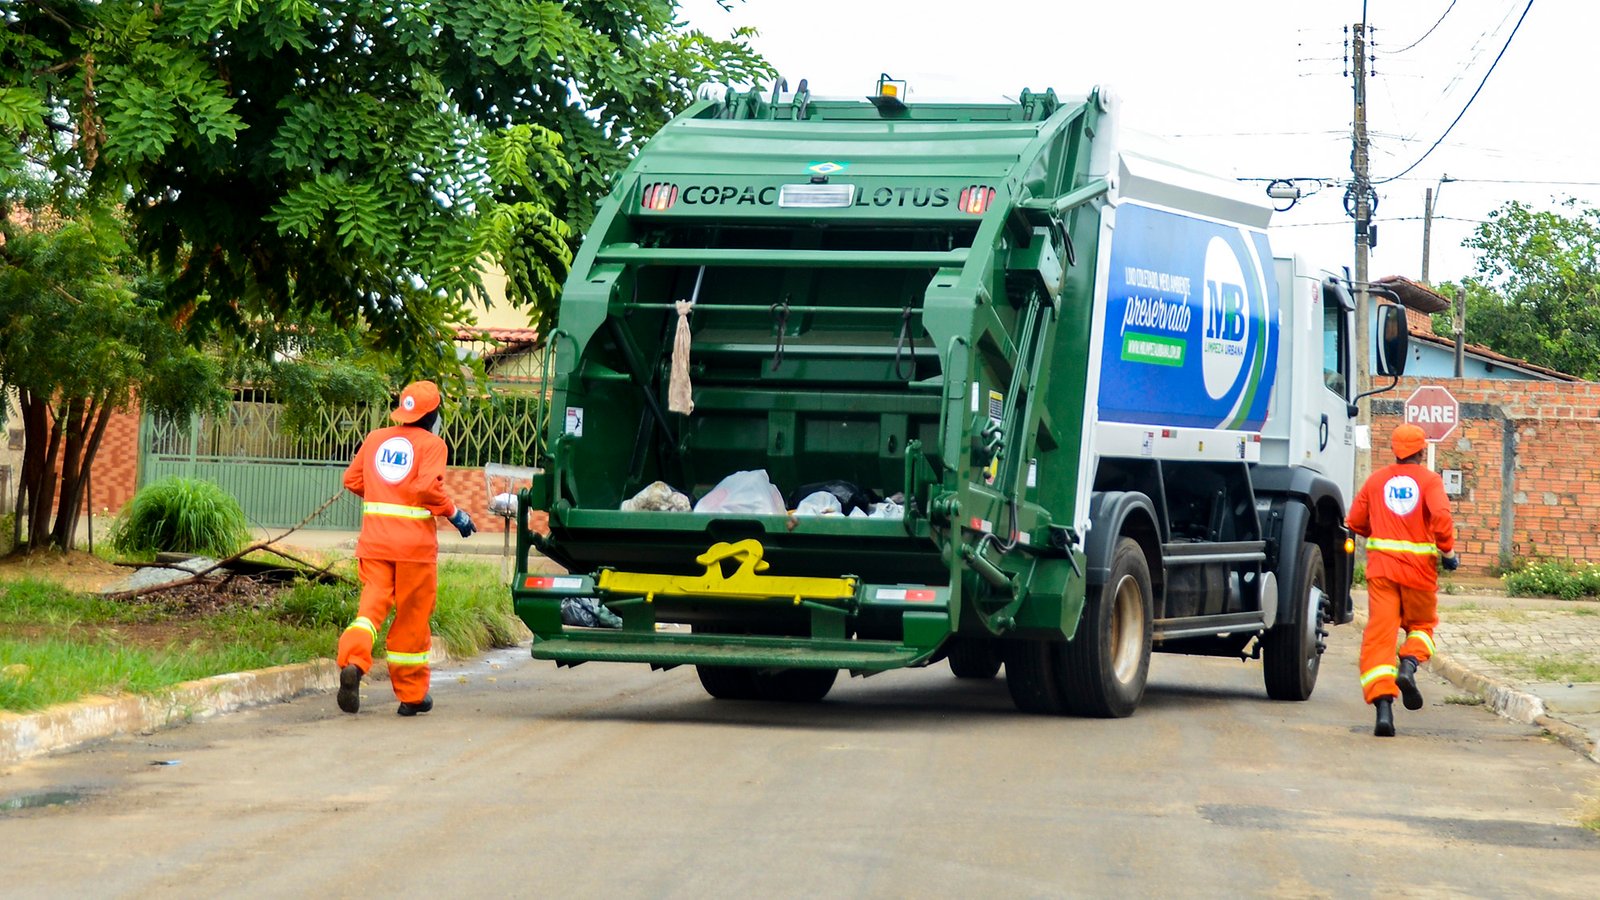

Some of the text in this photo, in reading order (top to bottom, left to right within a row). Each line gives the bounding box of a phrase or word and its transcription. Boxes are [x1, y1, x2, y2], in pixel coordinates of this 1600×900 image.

[682, 185, 950, 207] COPAC LOTUS
[1120, 293, 1191, 337] preservado
[1206, 279, 1245, 341] MB
[1204, 342, 1244, 356] LIMPEZA URBANA
[1408, 405, 1454, 423] PARE
[380, 448, 408, 466] MB
